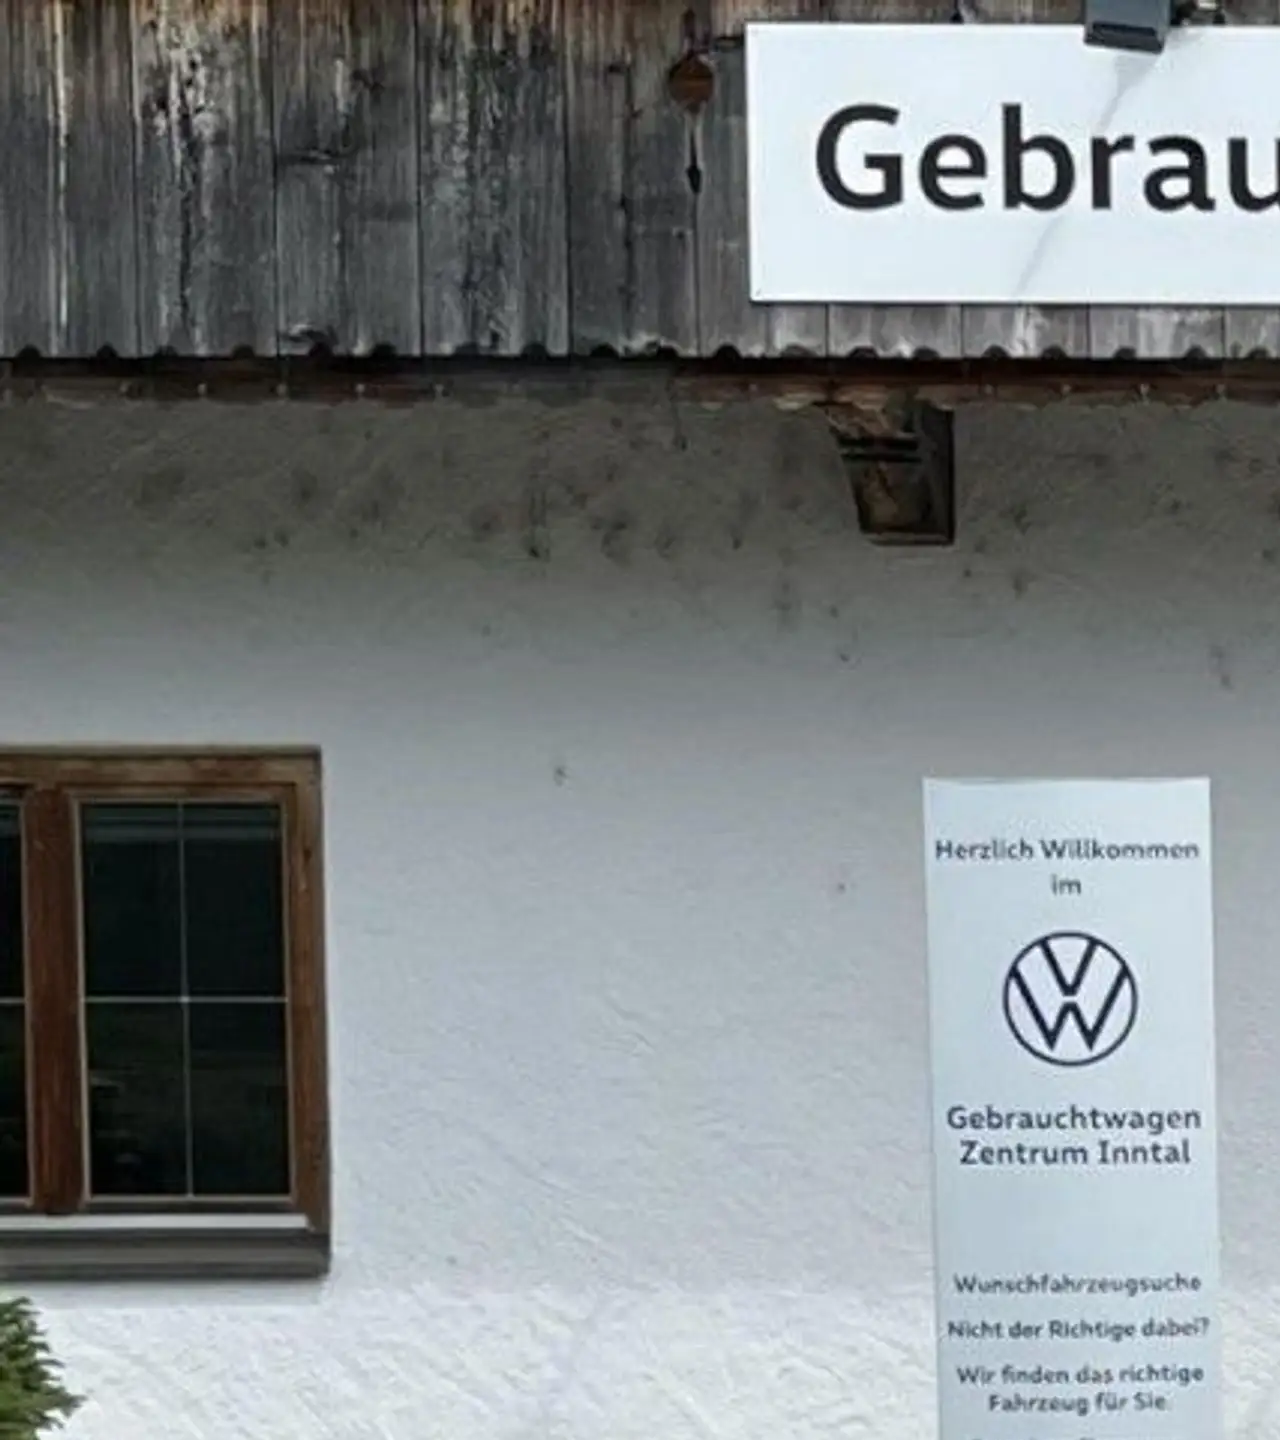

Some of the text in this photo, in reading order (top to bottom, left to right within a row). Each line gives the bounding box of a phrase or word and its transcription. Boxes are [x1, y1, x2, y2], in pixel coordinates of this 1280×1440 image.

[935, 838, 1199, 860] Herzlich Willkommen
[1051, 873, 1082, 895] im
[1001, 930, 1139, 1068] VW
[946, 1103, 1202, 1136] Gebrauchtwagen
[959, 1138, 1191, 1166] Zentrum Inntal
[953, 1272, 1202, 1297] Wunschfahrzeugsuche
[947, 1316, 1210, 1343] Nicht der Richtige dabei?
[956, 1363, 1205, 1387] Wir finden das richtige
[988, 1393, 1090, 1417] Fahrzeug
[1095, 1391, 1127, 1411] für
